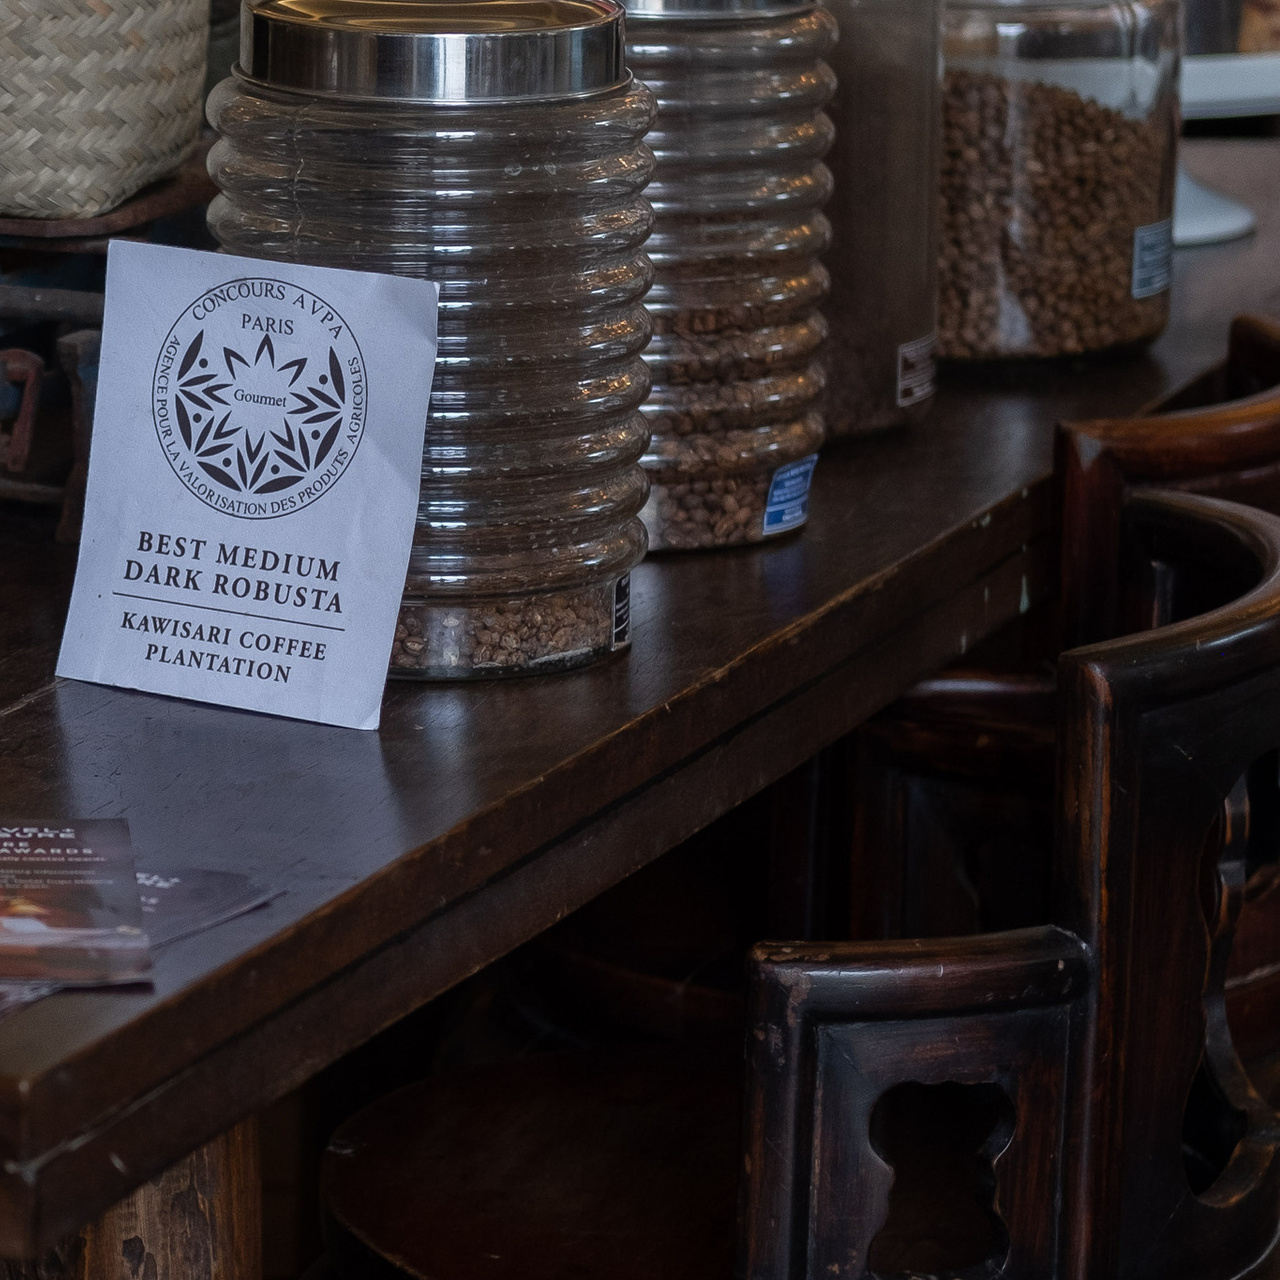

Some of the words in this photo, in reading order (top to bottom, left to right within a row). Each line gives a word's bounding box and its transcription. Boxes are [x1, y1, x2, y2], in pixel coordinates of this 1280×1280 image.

[192, 281, 286, 322] CONCOURS
[241, 313, 294, 336] PARIS
[157, 335, 181, 394] AGENCE
[157, 399, 172, 438] POUR
[233, 388, 287, 408] Gourmet
[347, 357, 364, 444] AGRICOLES
[166, 441, 180, 462] LA
[179, 461, 267, 515] VALORISATION
[298, 448, 349, 503] PRODUTS
[271, 497, 297, 513] DES
[137, 530, 207, 561] BEST
[216, 543, 341, 581] MEDIUM
[124, 560, 202, 592] DARK
[212, 575, 343, 614] ROBUSTA
[120, 612, 232, 646] KAWISARI
[239, 631, 327, 661] COFFEE
[145, 643, 291, 684] PLANTATION
